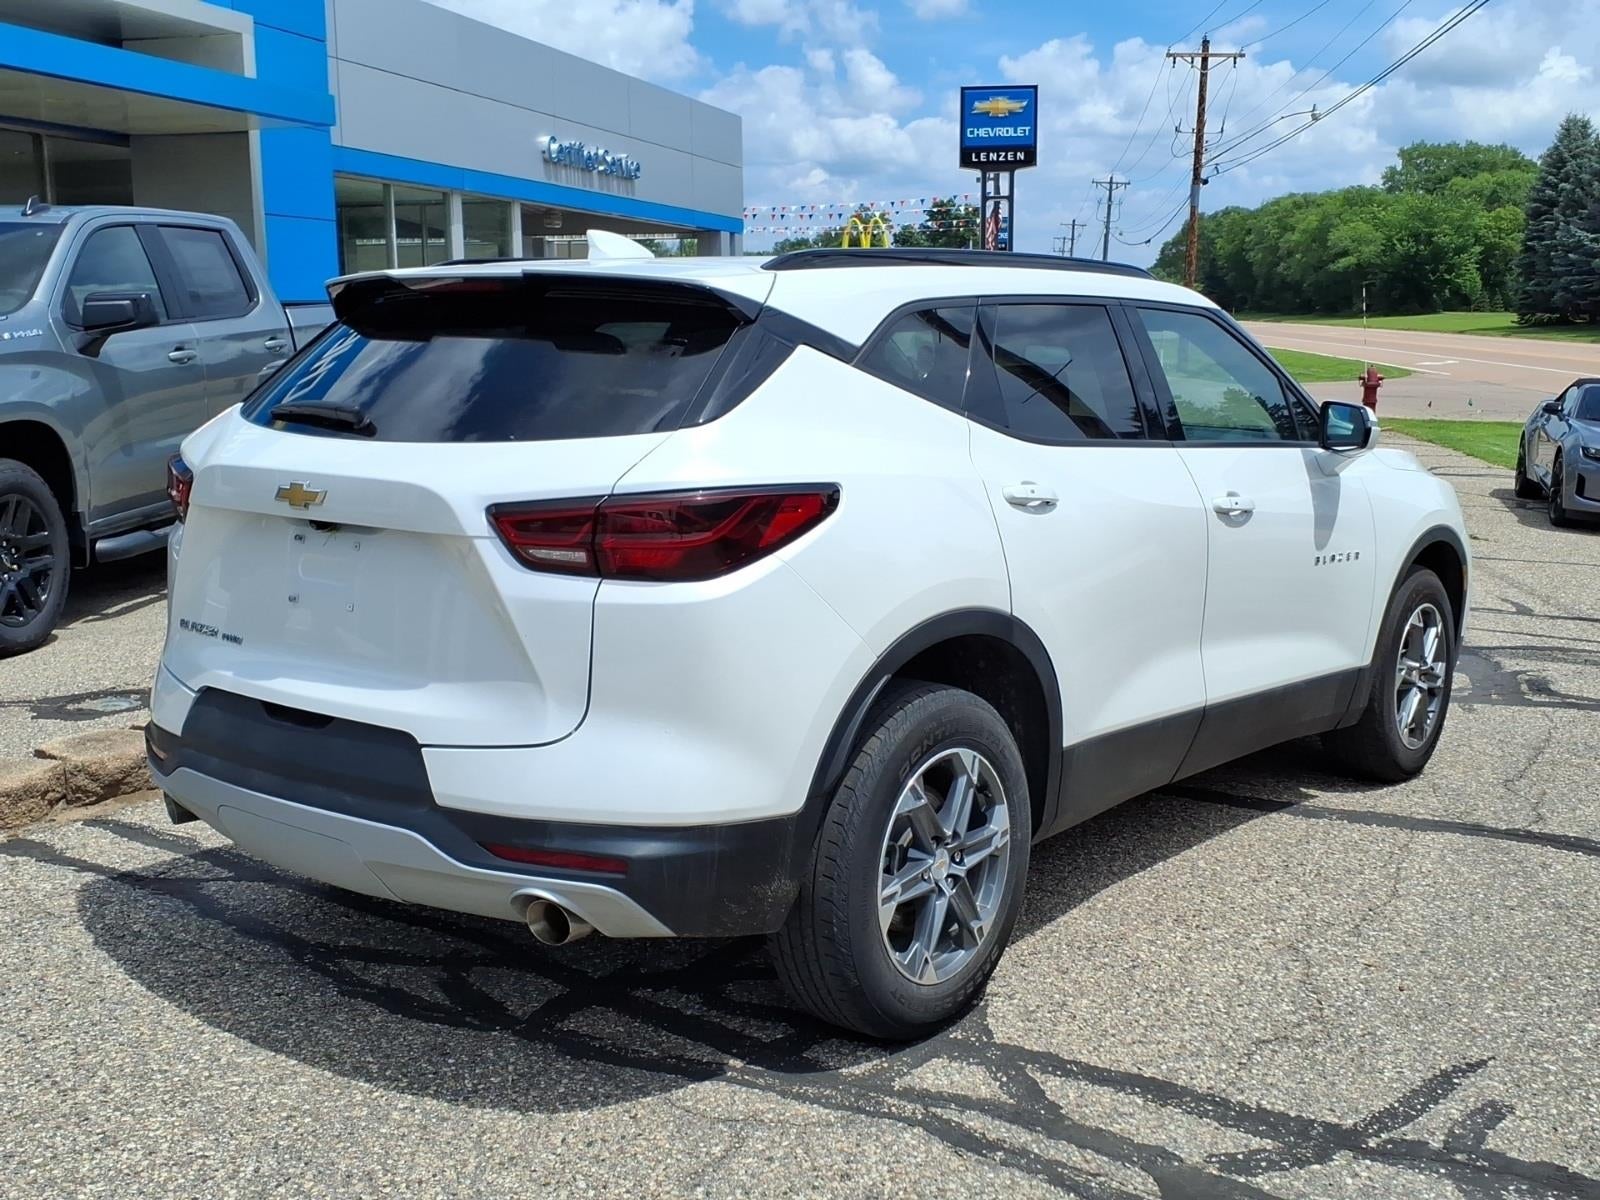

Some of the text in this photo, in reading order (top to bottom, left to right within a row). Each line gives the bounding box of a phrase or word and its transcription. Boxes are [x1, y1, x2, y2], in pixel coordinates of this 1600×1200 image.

[967, 126, 1031, 138] CHEVROLET
[545, 135, 641, 180] Certified Service
[971, 151, 1025, 162] LENZEN
[1314, 551, 1360, 567] BLAZER
